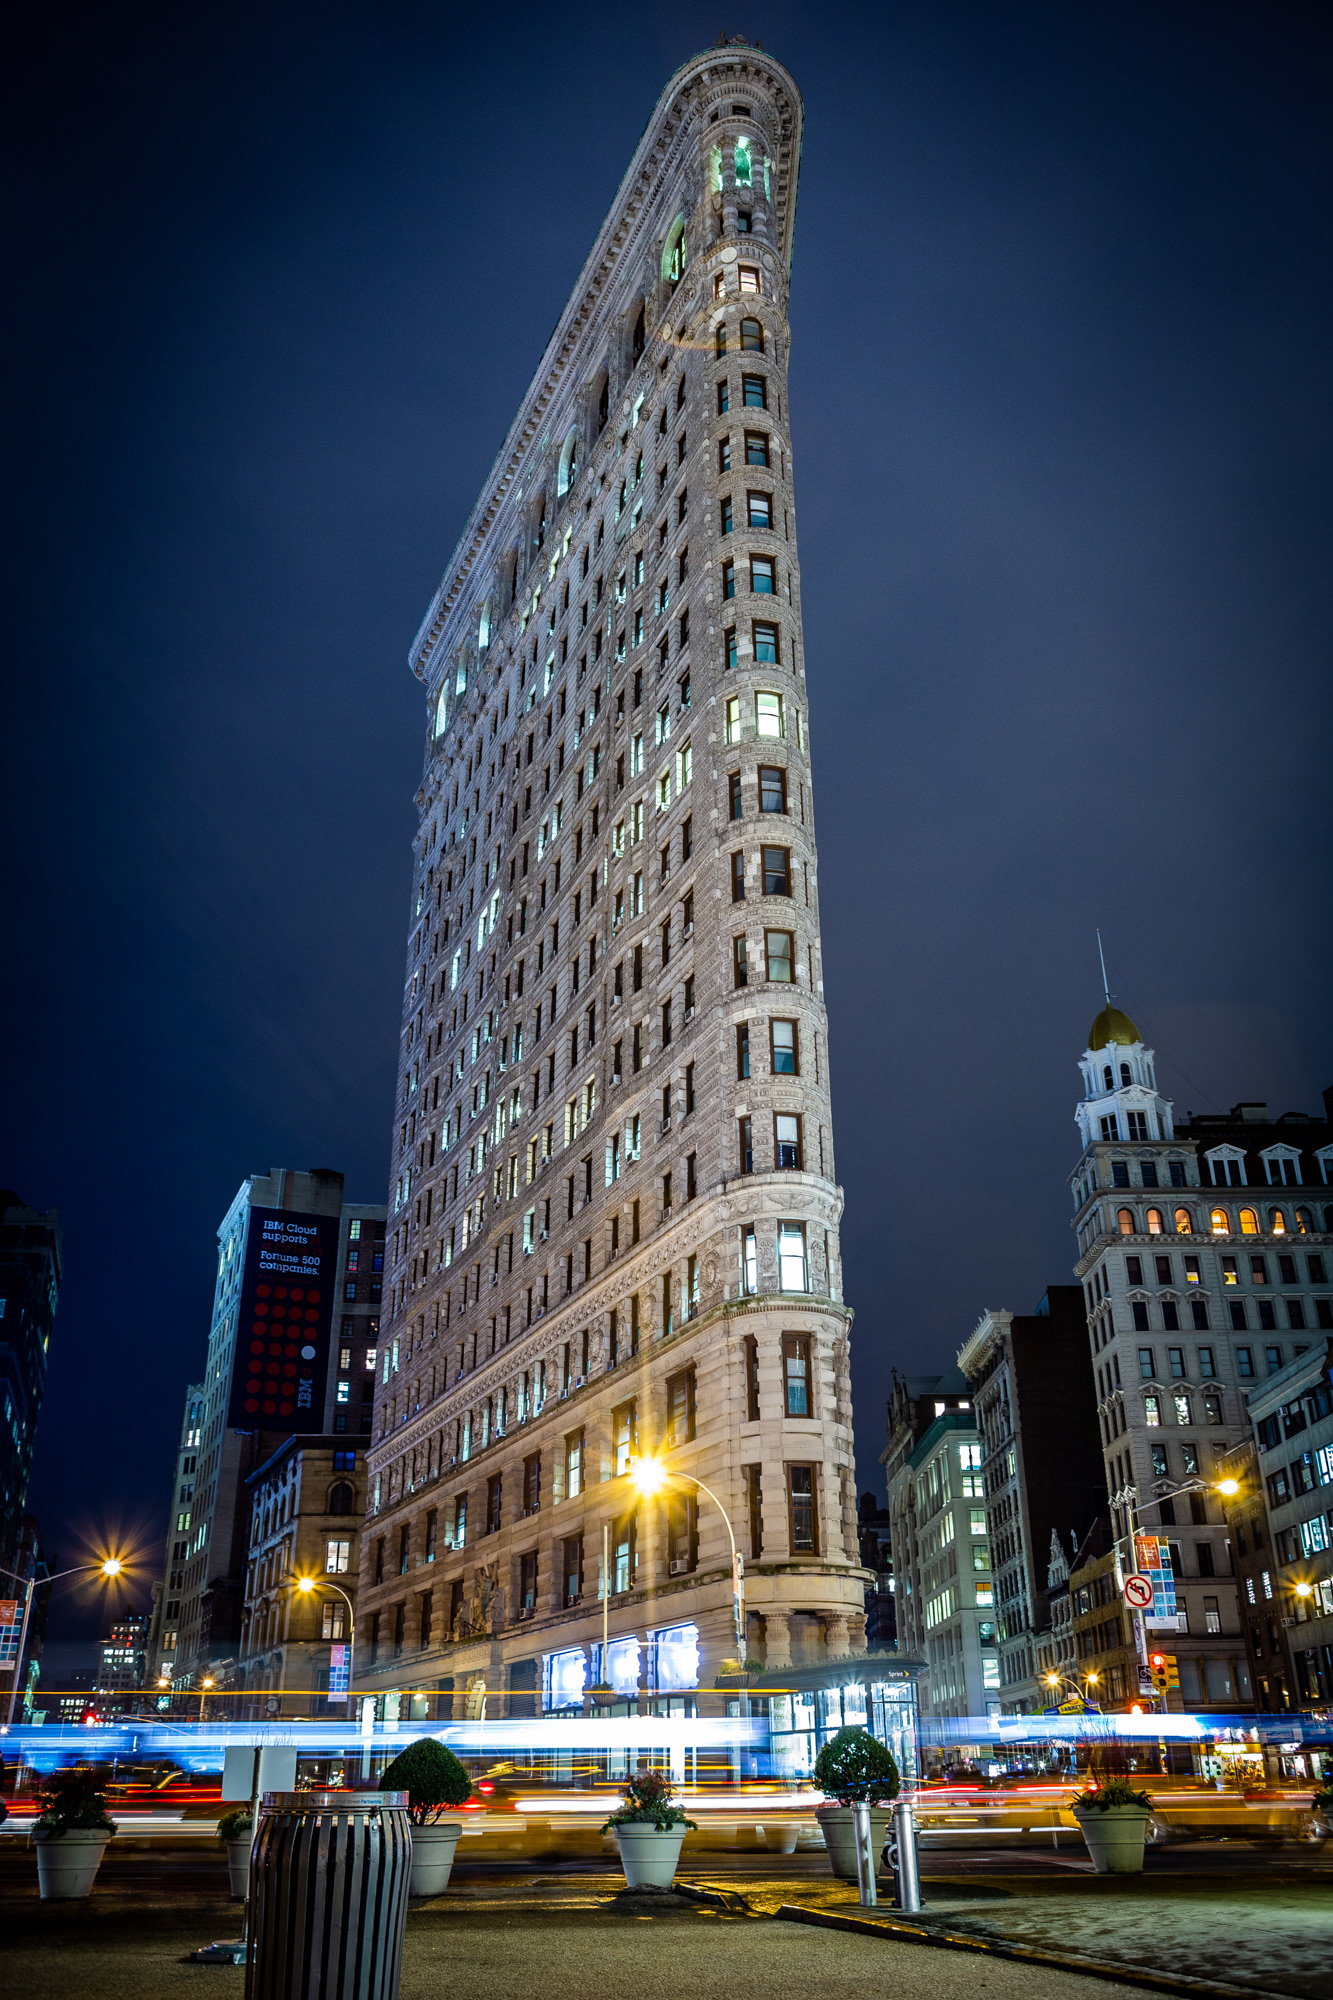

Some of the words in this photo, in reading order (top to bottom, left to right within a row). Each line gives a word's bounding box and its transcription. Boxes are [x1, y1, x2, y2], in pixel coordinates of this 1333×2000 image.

[263, 1220, 285, 1231] IBM
[286, 1223, 318, 1236] Cloud
[262, 1232, 308, 1244] supports
[261, 1241, 272, 1250] of
[274, 1242, 291, 1253] the
[293, 1245, 311, 1256] top
[311, 1247, 324, 1257] 25
[260, 1250, 299, 1263] Fortune
[302, 1255, 320, 1266] 500
[259, 1261, 320, 1276] companies.
[297, 1378, 313, 1408] IBM
[1161, 1548, 1169, 1556] 19
[1153, 1571, 1161, 1579] 18
[1155, 1595, 1164, 1603] 23
[888, 1670, 904, 1678] Sprint
